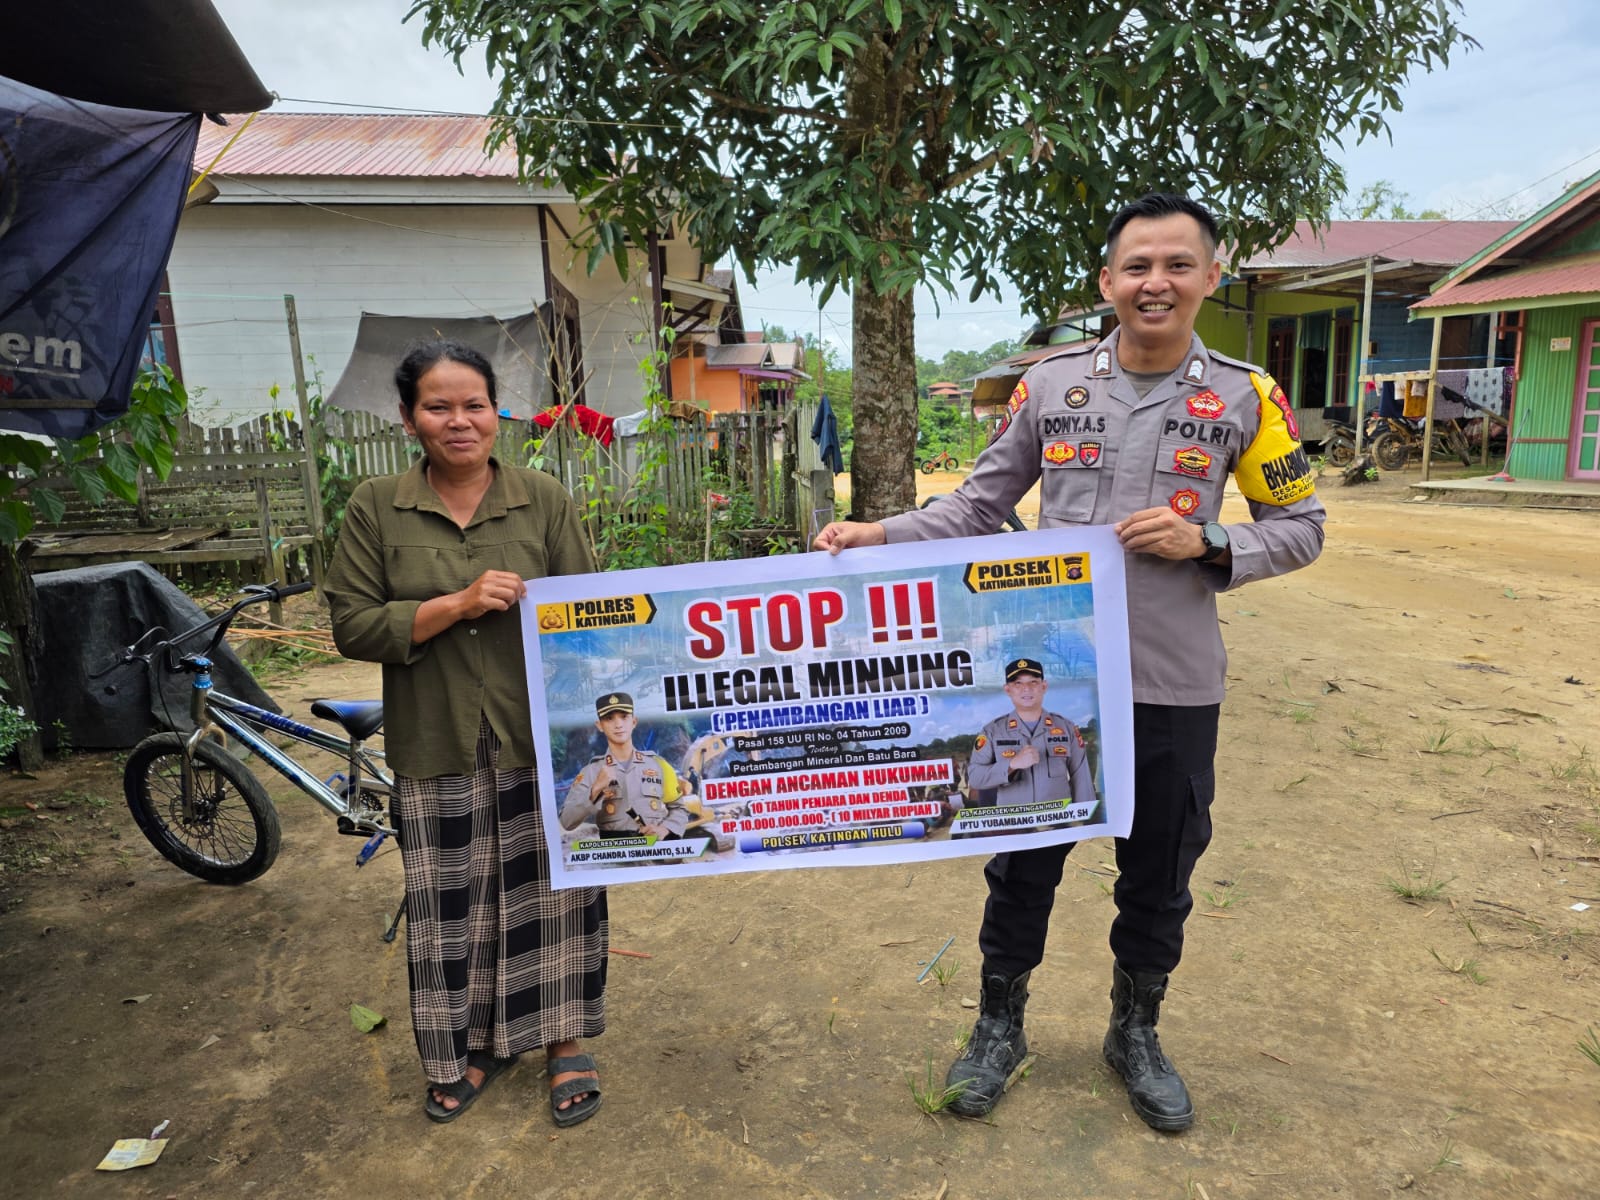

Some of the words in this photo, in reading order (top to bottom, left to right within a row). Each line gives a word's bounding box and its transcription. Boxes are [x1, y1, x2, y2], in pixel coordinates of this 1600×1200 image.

[1163, 419, 1231, 446] POLRI
[978, 560, 1051, 580] POLSEK
[979, 576, 1026, 591] KATINGAN
[1028, 574, 1053, 587] HULU
[574, 598, 635, 616] POLRES
[575, 612, 636, 629] KATINGAN
[687, 589, 844, 660] STOP
[868, 581, 938, 644] !!!
[663, 665, 801, 712] ILLEGAL
[807, 649, 974, 699] MINNING
[738, 737, 765, 749] Pasal
[768, 736, 785, 746] 158
[787, 734, 802, 744] UU
[804, 733, 815, 743] RI
[817, 732, 834, 742] No.
[837, 730, 849, 740] 04
[851, 729, 881, 739] Tahun
[883, 726, 907, 736] 2009
[733, 758, 804, 773] Pertambangan
[806, 754, 843, 767] Mineral
[845, 753, 865, 763] Dan
[867, 751, 891, 761] Batu
[893, 749, 917, 759] Bara
[705, 778, 773, 801] DENGAN
[776, 770, 860, 794] ANCAMAN
[863, 763, 950, 787] HUKUMAN
[751, 801, 763, 815] 10
[766, 798, 800, 813] TAHUN
[802, 794, 847, 809] PENJARA
[848, 792, 870, 805] DAN
[872, 789, 908, 804] DENDA
[1010, 803, 1044, 813] KATINGAN
[1045, 801, 1063, 809] HULU
[722, 821, 738, 833] RP.
[838, 810, 851, 822] 10
[852, 807, 891, 821] MILYAR
[893, 803, 933, 818] RUPIAH
[959, 820, 979, 830] IPTU
[981, 814, 1034, 828] YUBAMBANG
[1077, 809, 1089, 818] SH
[614, 838, 647, 847] KATINGAN
[762, 834, 807, 849] POLSEK
[810, 828, 868, 844] KATINGAN
[872, 825, 903, 839] HULU
[571, 852, 591, 862] AKBP
[592, 850, 627, 861] CHANDRA
